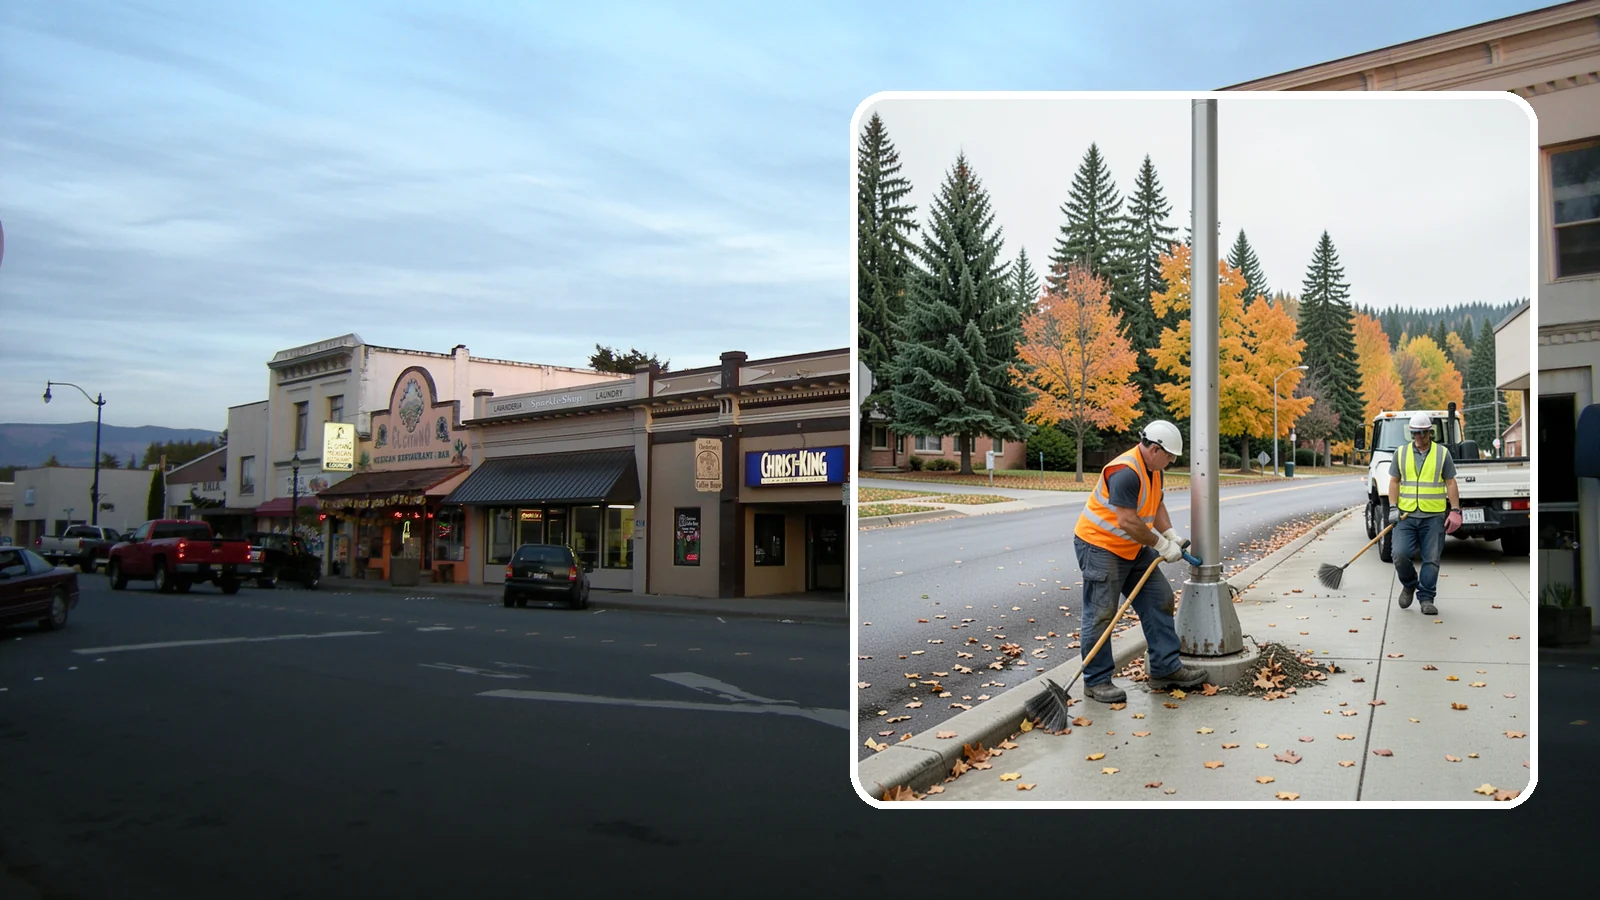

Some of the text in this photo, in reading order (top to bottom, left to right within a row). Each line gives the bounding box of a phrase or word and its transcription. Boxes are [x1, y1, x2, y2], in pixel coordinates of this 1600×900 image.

[530, 394, 582, 409] Sparkle Shop
[595, 389, 623, 400] LAUNDRY
[493, 402, 522, 413] LAVANDERIA
[374, 455, 396, 464] MEXICAN
[397, 452, 434, 462] RESTAURANT
[438, 450, 450, 459] BAR
[761, 449, 827, 478] CHRIST KING
